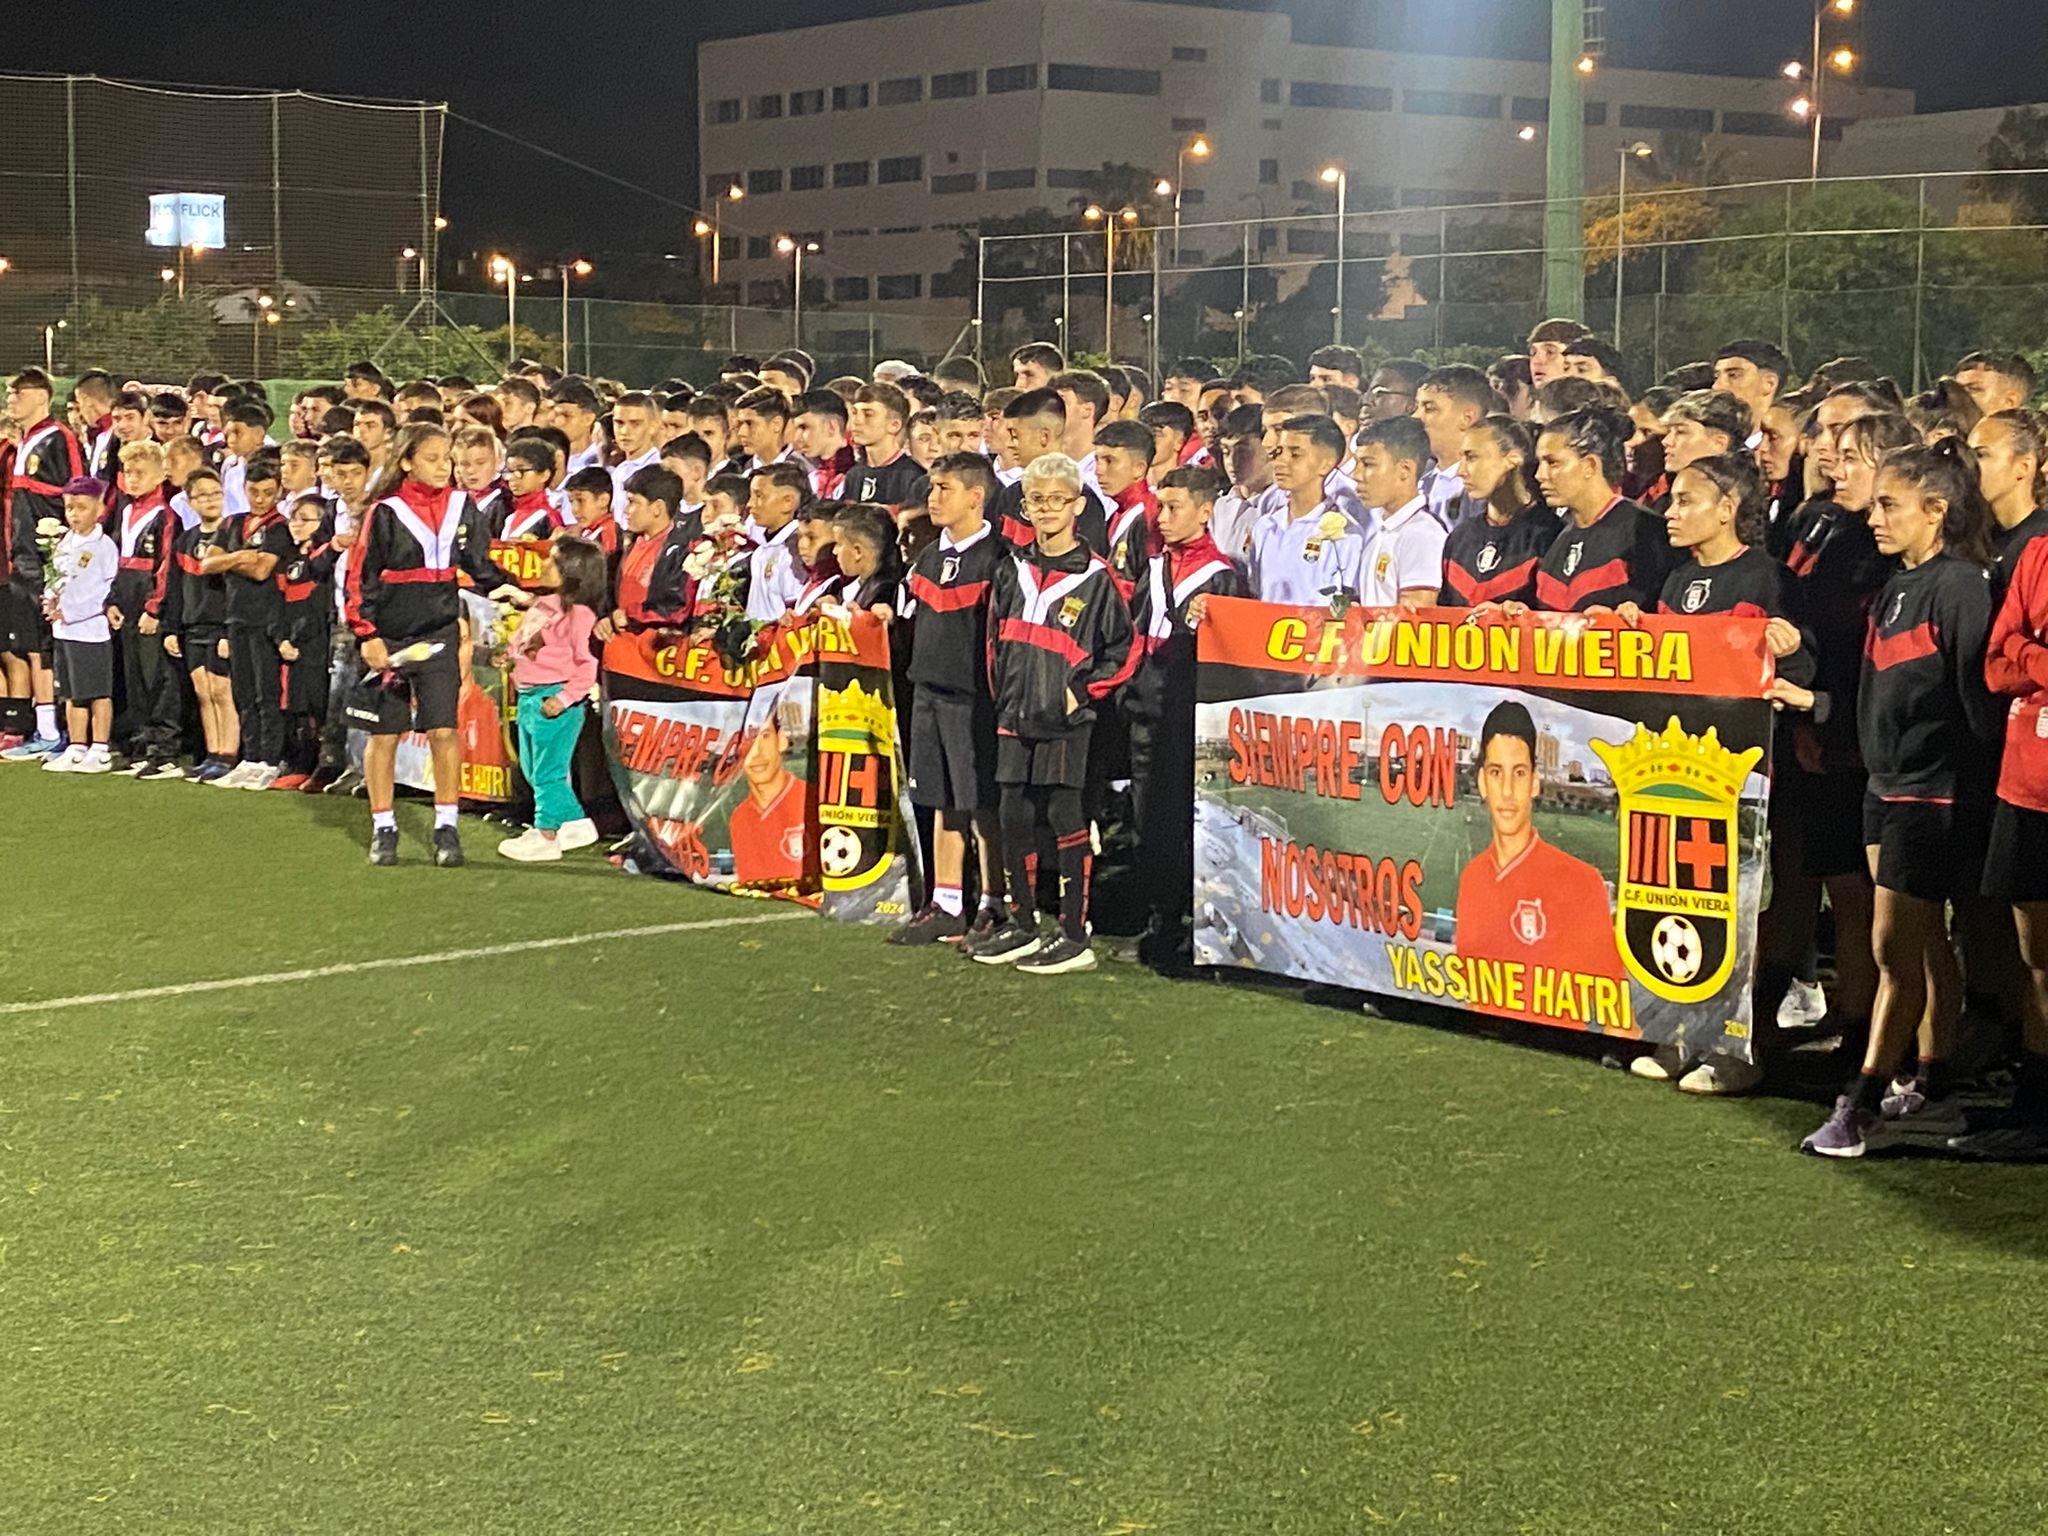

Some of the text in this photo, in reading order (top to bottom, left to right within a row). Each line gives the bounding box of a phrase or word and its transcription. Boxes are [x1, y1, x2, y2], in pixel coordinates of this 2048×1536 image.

[181, 203, 221, 218] FLICK
[1266, 615, 1693, 682] C.F. UNIÓN VIERA
[1228, 707, 1457, 809] SIEMPRE CON
[1261, 837, 1424, 941] NOSOTROS
[1646, 891, 1688, 907] UNIÓN
[1692, 896, 1731, 912] VIERA
[1385, 943, 1633, 1030] YASSINE HATRI
